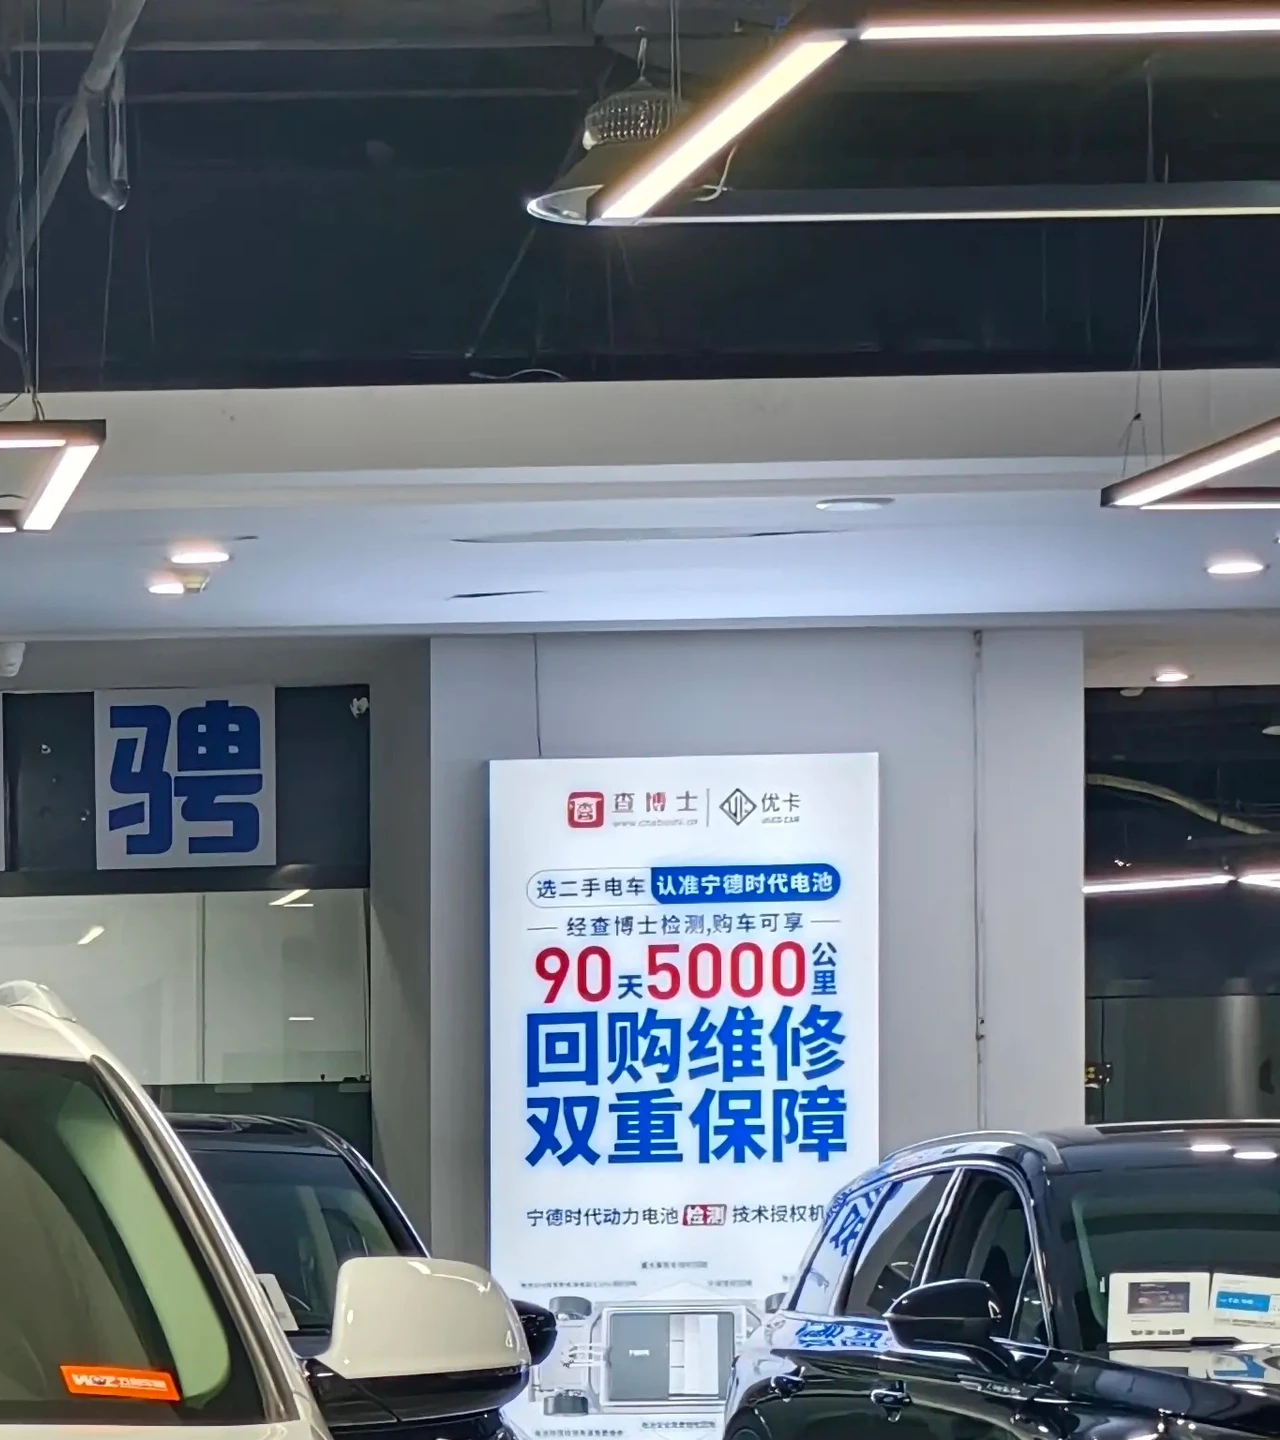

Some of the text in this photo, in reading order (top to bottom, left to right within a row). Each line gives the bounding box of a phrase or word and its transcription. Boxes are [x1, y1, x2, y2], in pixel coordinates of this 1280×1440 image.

[760, 792, 802, 813] 优卡
[537, 876, 646, 899] 选二手电车
[656, 871, 834, 896] 认准宁德时代电池
[526, 1004, 846, 1088] 回购维修
[525, 1085, 847, 1166] 双重保障
[526, 1206, 680, 1227] 宁德时代动力电池
[686, 1204, 725, 1225] 检测
